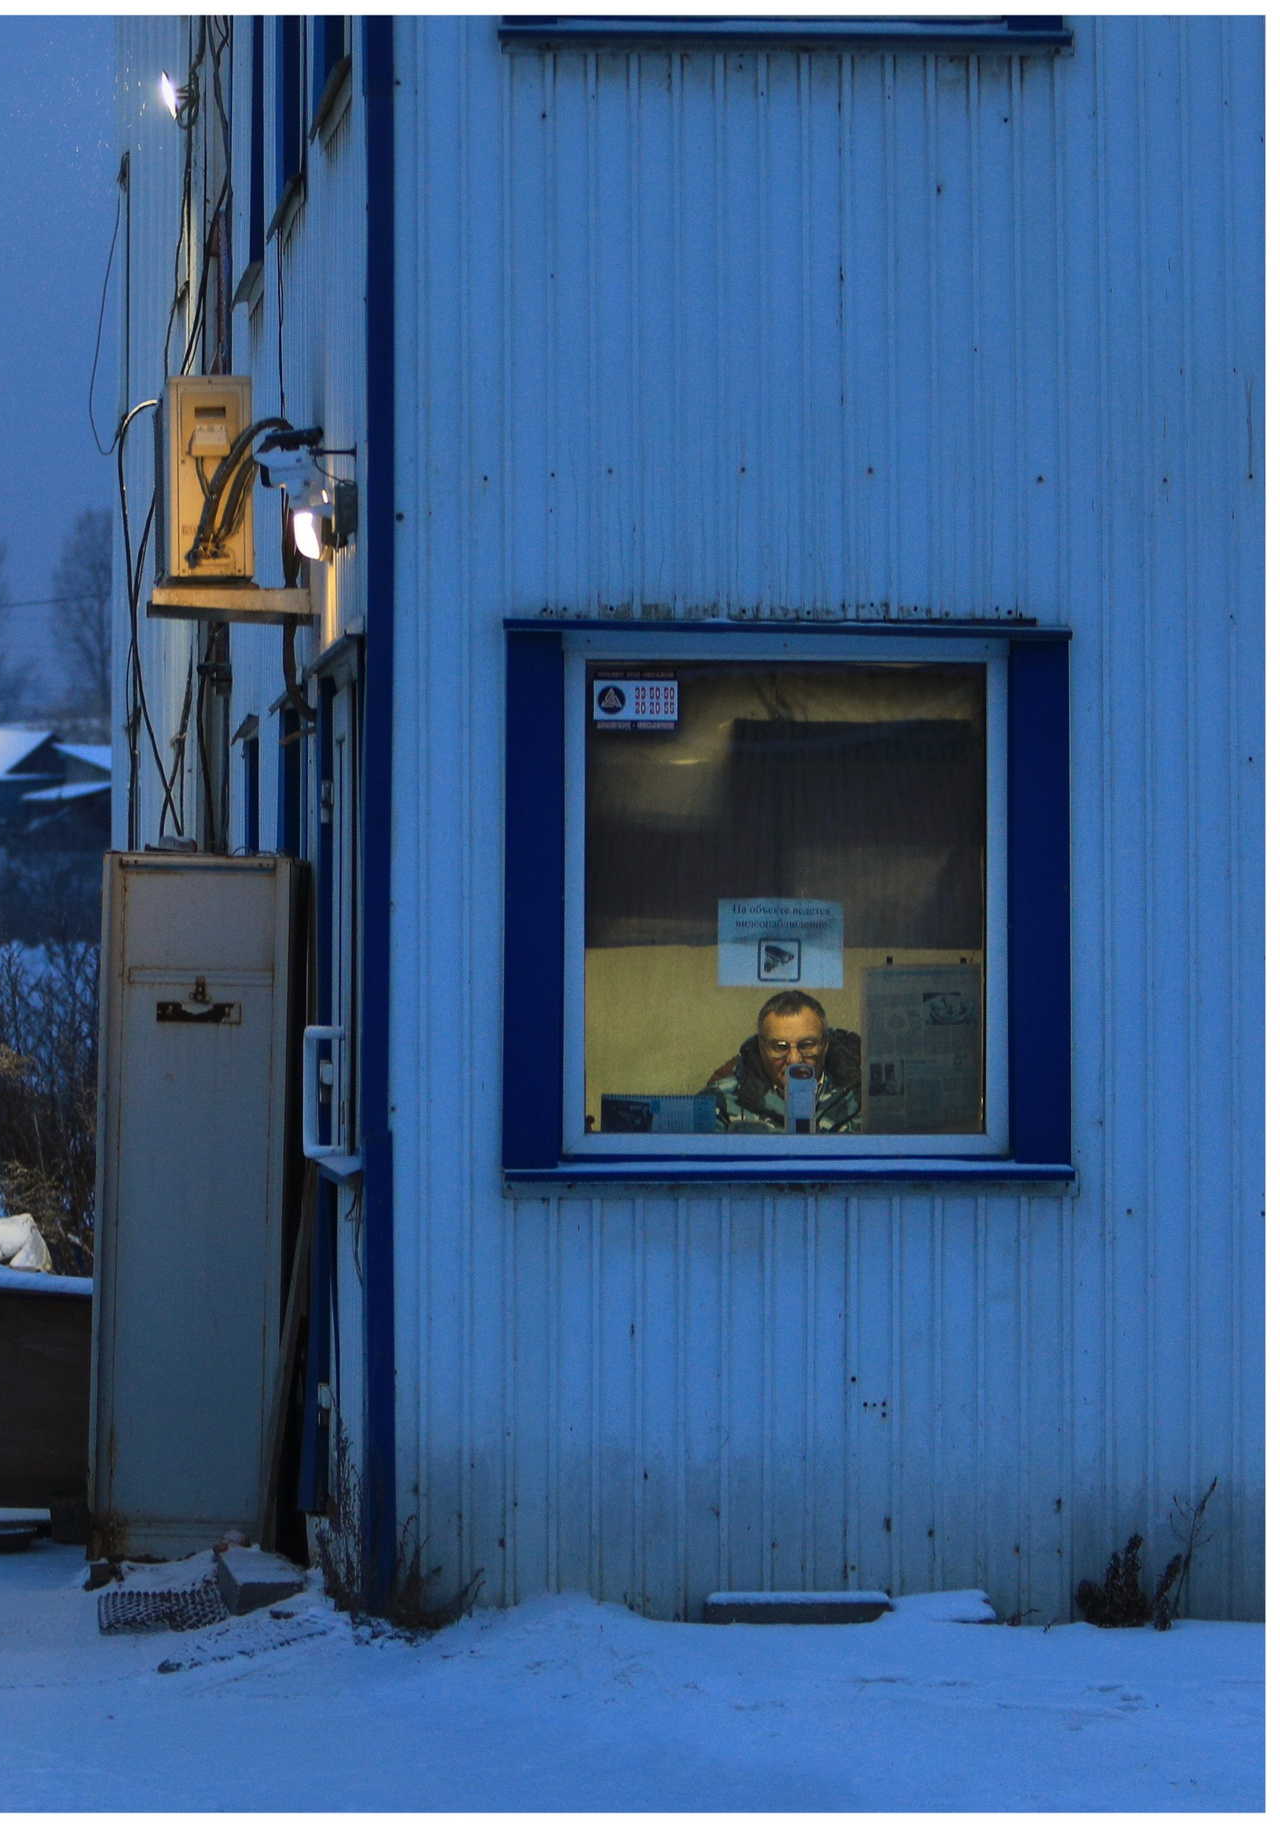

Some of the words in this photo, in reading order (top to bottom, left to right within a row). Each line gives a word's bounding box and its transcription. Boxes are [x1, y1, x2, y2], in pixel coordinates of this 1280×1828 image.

[635, 686, 646, 700] 33
[650, 686, 661, 700] 50
[664, 686, 675, 700] 50
[635, 701, 646, 715] 20
[650, 701, 661, 715] 20
[732, 903, 747, 914] На
[749, 904, 790, 915] объекте
[735, 919, 827, 929] видеонаблюдение
